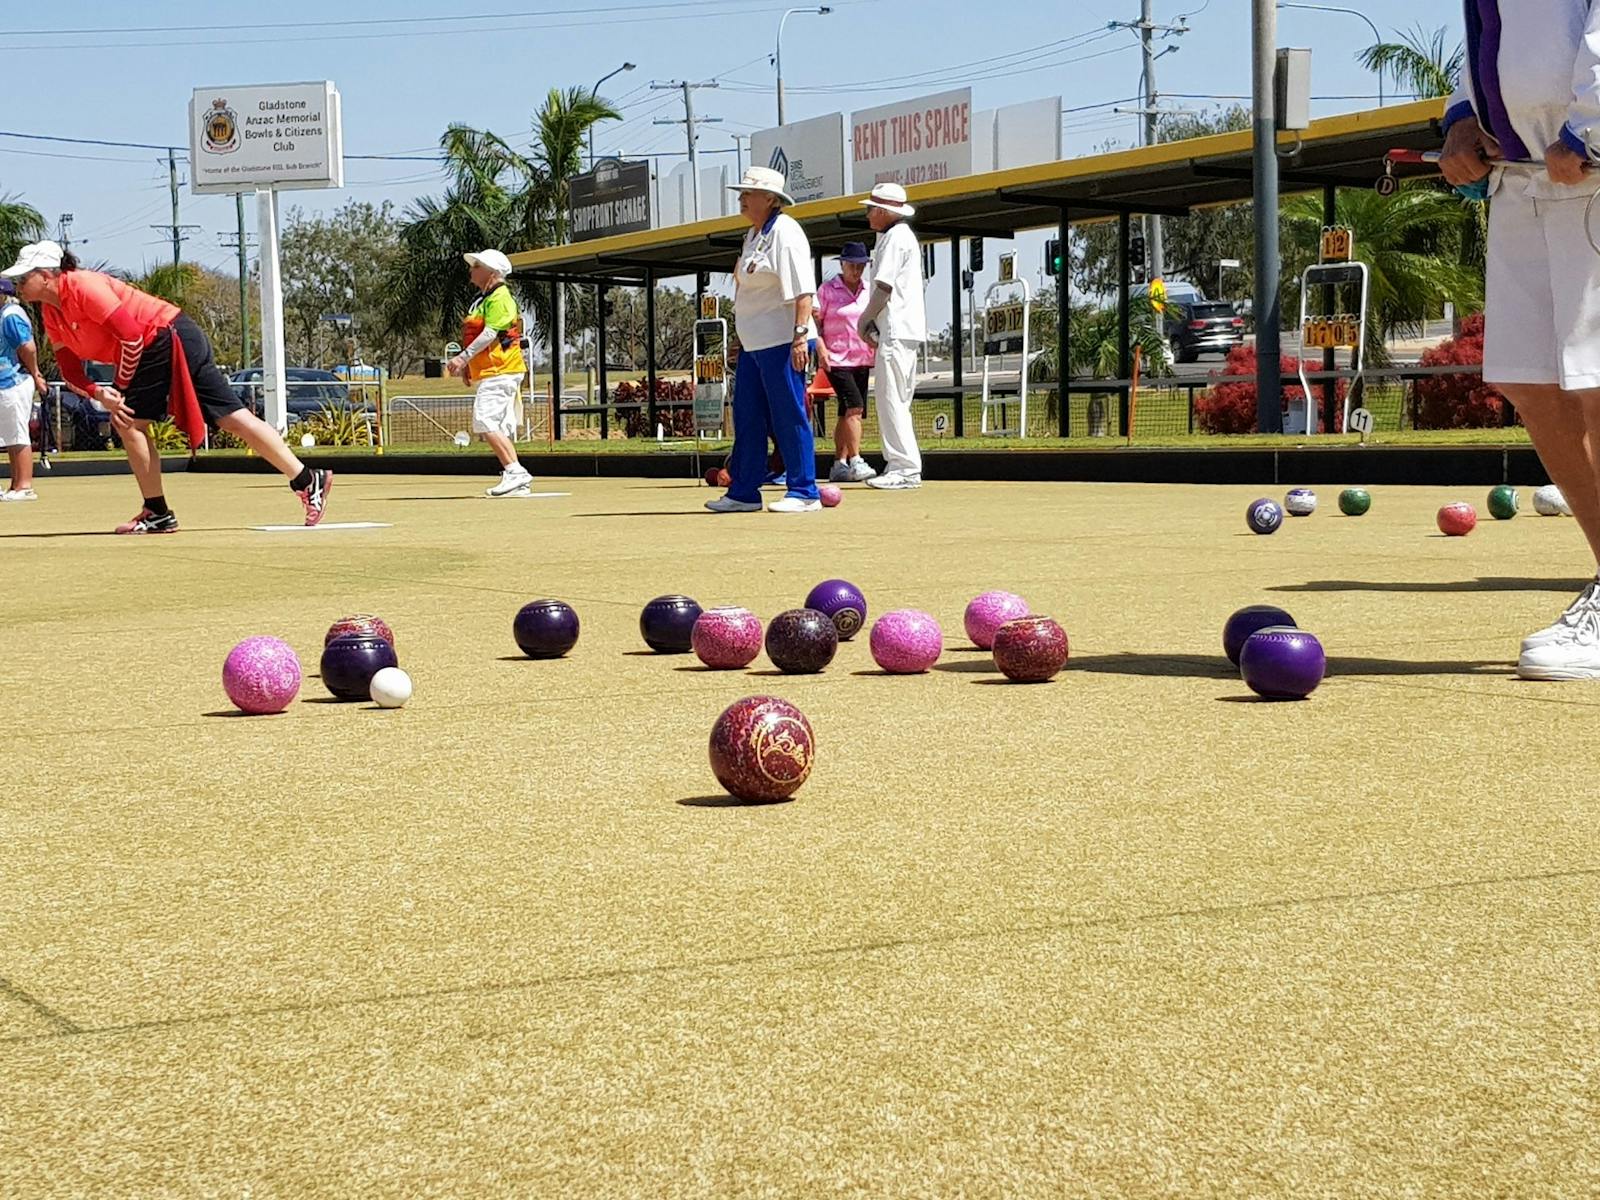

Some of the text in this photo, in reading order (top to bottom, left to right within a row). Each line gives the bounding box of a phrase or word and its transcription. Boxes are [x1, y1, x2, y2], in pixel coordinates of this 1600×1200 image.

[258, 100, 306, 111] Gladstone
[246, 112, 321, 125] Anzac Memorial
[245, 126, 322, 139] Bowls & Citizens
[854, 103, 969, 162] RENT THIS SPACE
[273, 141, 295, 152] Club
[1380, 178, 1393, 194] D
[614, 195, 647, 226] SIGNAGE
[1324, 234, 1345, 255] 12
[935, 415, 945, 430] 12
[1355, 411, 1369, 431] 11
